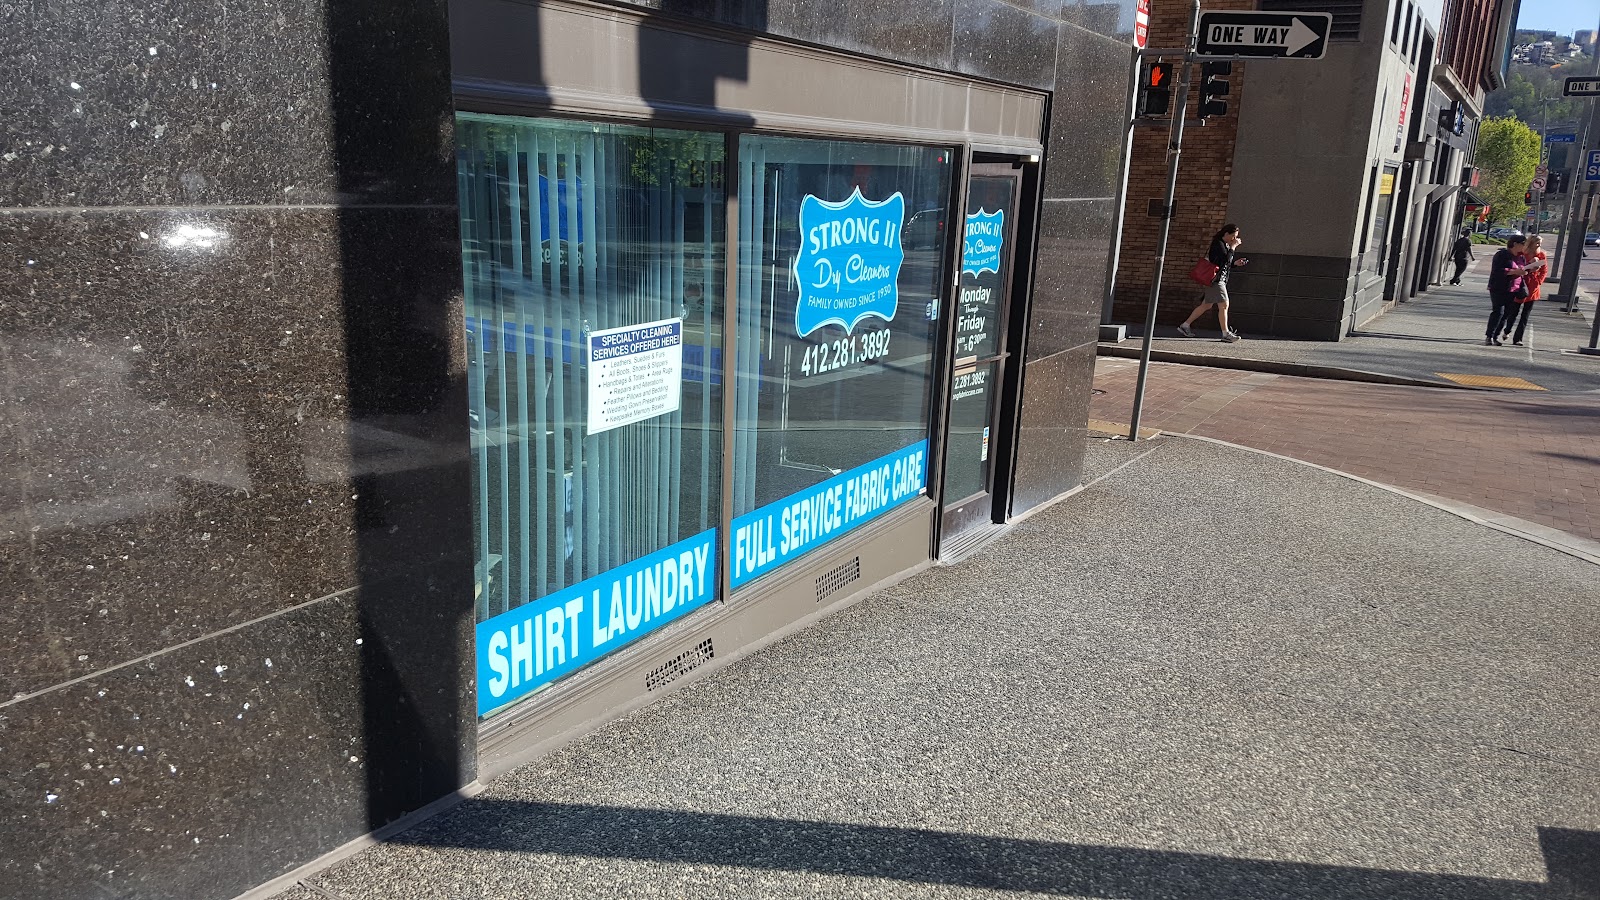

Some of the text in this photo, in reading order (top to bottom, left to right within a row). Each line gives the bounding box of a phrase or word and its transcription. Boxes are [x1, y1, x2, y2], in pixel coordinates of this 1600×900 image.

[1211, 25, 1289, 45] ONE WAY
[1571, 82, 1590, 91] ONE
[809, 216, 896, 255] STRONG II
[966, 221, 992, 237] TRONG
[811, 253, 890, 293] Dry Cleaners
[807, 285, 892, 310] FAMILY OWNED SINCE 1930
[957, 314, 985, 332] Friday
[602, 325, 673, 347] SPECIALTY CLEANING
[593, 334, 680, 360] SERVICES OFFERED HERE!
[634, 354, 651, 364] Suedes
[655, 351, 665, 359] Furs
[801, 328, 891, 377] 412.281.3892
[602, 377, 628, 388] Handbags
[651, 368, 661, 376] Area
[608, 369, 616, 378] All
[632, 364, 647, 373] Shoes
[651, 359, 669, 370] Slippers
[613, 377, 664, 396] Repairs and Alterations
[954, 371, 985, 390] 2.281.3892
[606, 393, 668, 415] Wedding Gown Preservation
[607, 384, 669, 406] Feather Pillows and Bedding
[609, 412, 633, 424] Keepsake
[633, 407, 651, 417] Memory
[735, 450, 925, 579] FULL SERVICE FABRIC CARE
[487, 541, 710, 699] SHIRT LAUNDRY
